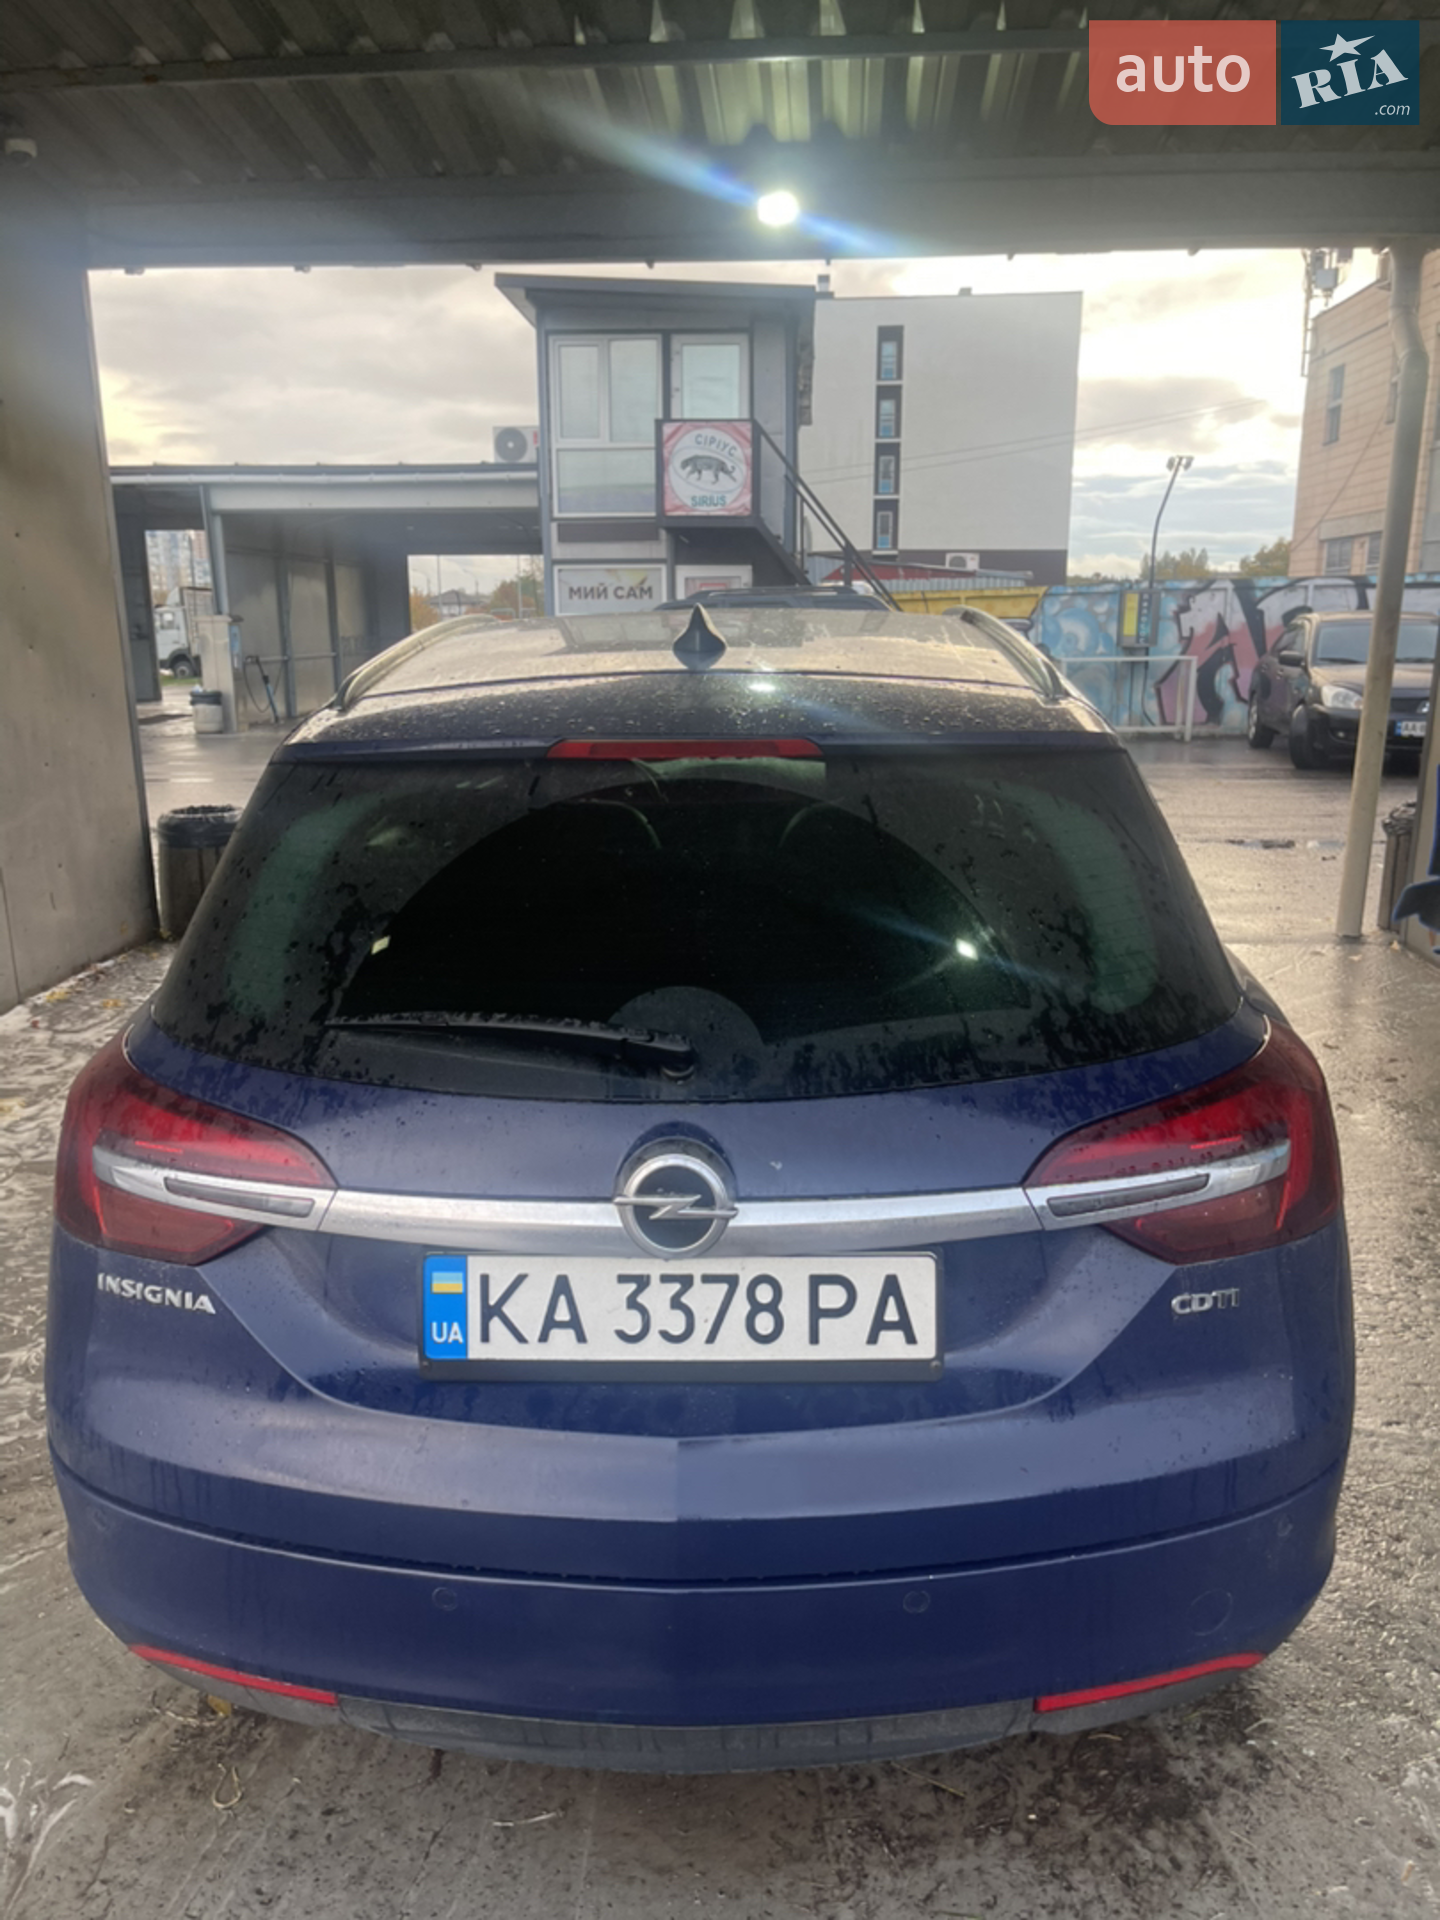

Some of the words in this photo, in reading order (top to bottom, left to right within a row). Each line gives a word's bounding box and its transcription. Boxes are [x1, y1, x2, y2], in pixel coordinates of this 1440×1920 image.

[694, 433, 737, 457] СІРІУС
[690, 495, 727, 508] SIRIUS
[568, 582, 609, 600] МИЙ
[613, 585, 653, 600] САМ
[97, 1272, 216, 1315] INSIGNIA
[1171, 1287, 1240, 1315] CDTI
[478, 1273, 589, 1345] KA
[613, 1273, 786, 1346] 3378
[808, 1273, 919, 1346] PA
[431, 1321, 464, 1344] UA
